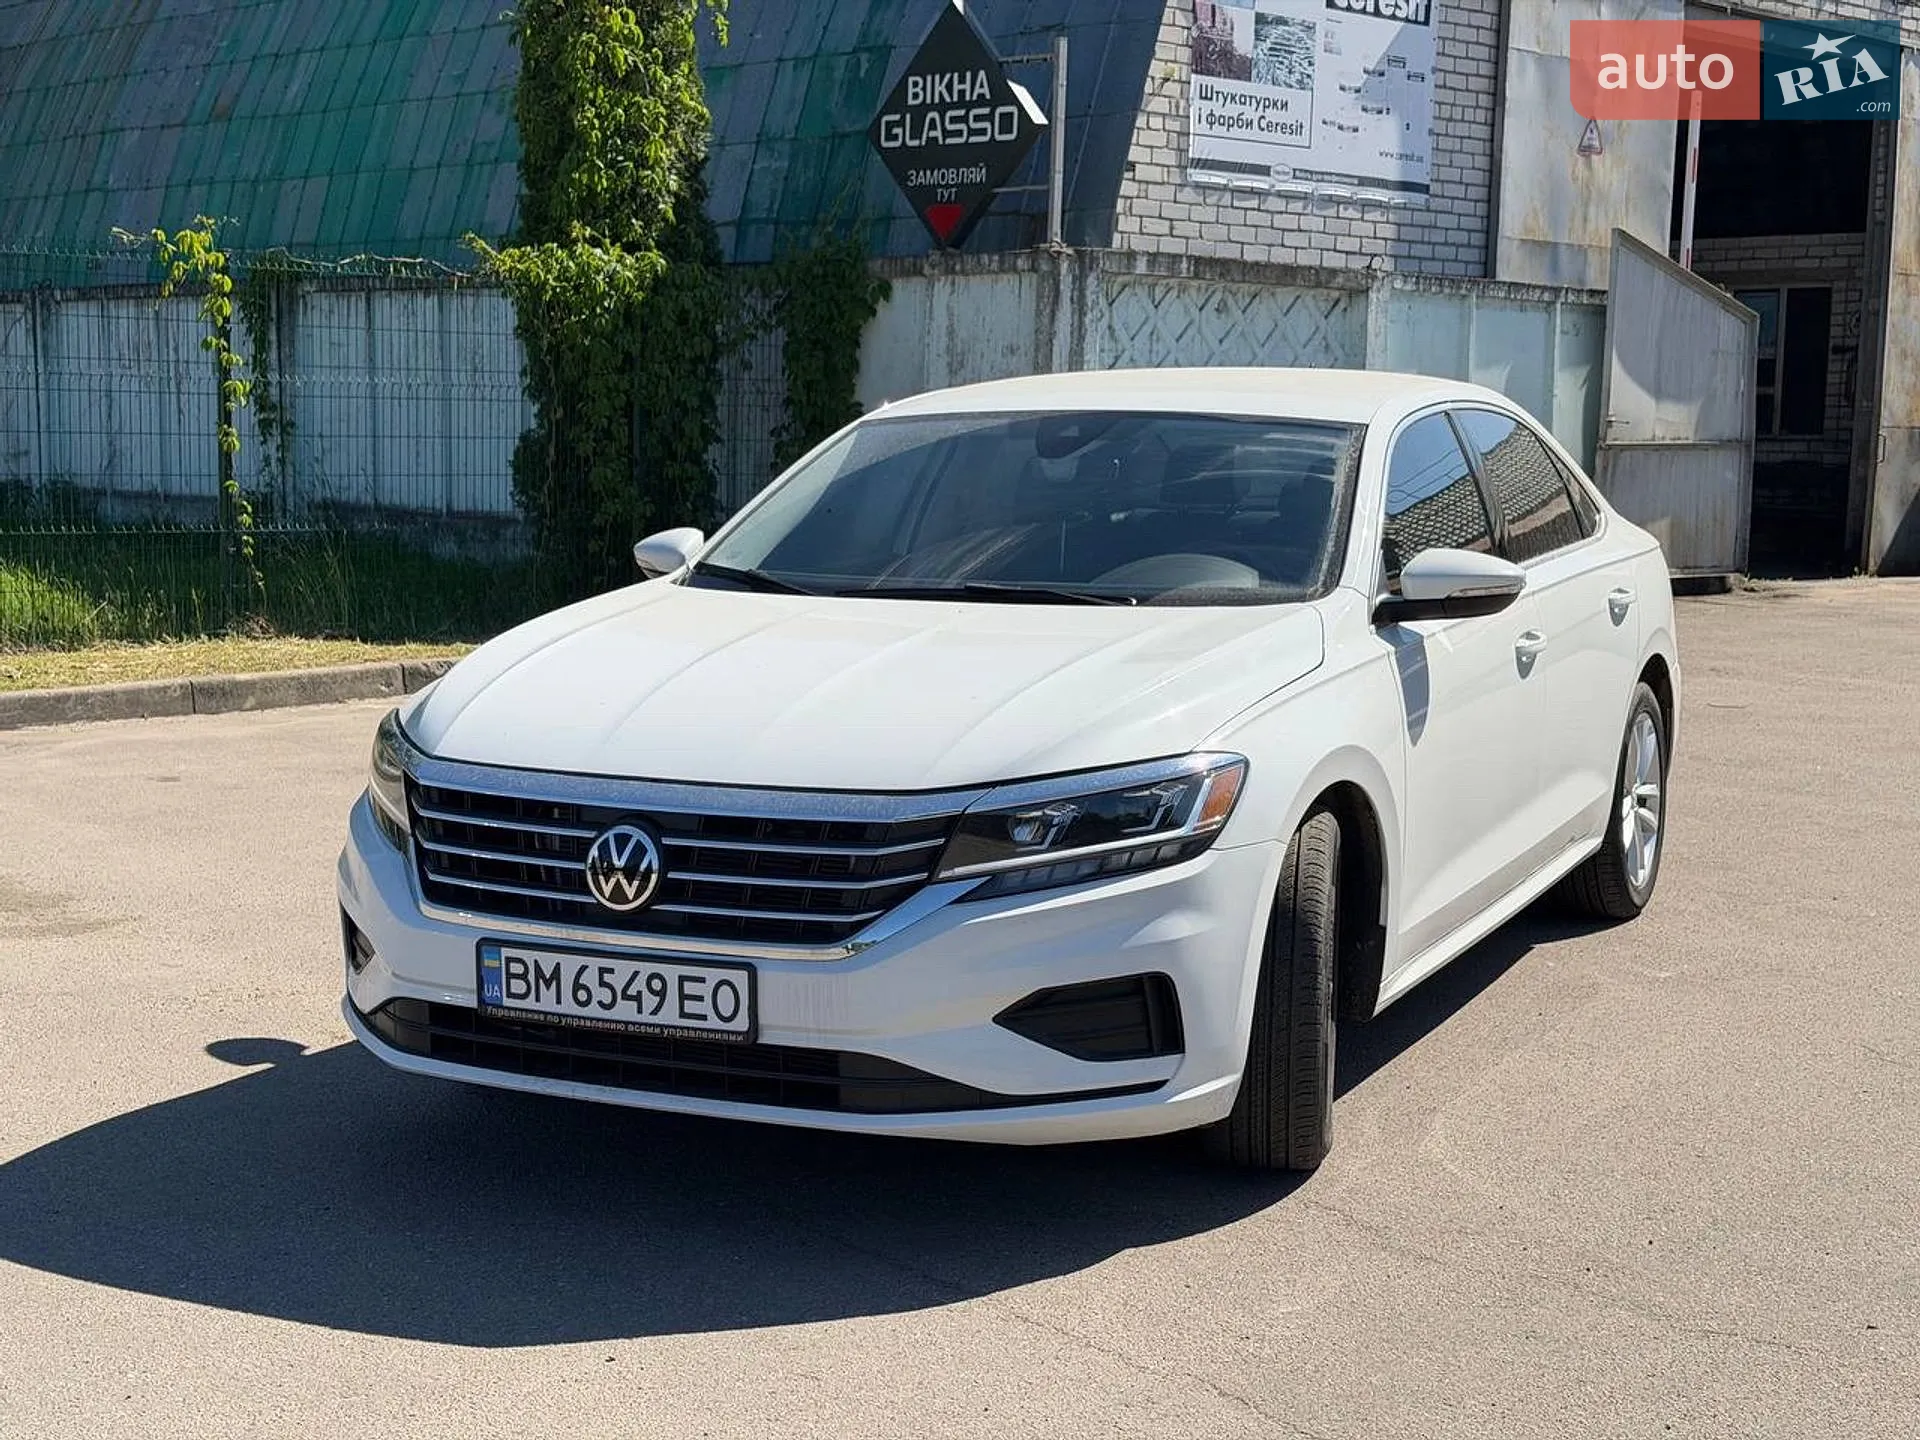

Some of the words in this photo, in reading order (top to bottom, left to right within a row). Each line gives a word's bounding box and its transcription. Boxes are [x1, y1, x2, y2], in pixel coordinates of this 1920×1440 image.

[907, 70, 991, 106] ВІКНА
[1199, 83, 1289, 112] Штукатурки
[880, 105, 1018, 148] GLASSO
[1205, 108, 1254, 132] фарби
[1257, 114, 1304, 137] Ceresit
[907, 163, 986, 187] ЗАМОВЛЯЙ
[937, 188, 957, 203] ТУТ
[484, 983, 501, 998] UA
[504, 956, 562, 1006] BM
[571, 964, 668, 1017] 6549
[678, 974, 741, 1024] EO
